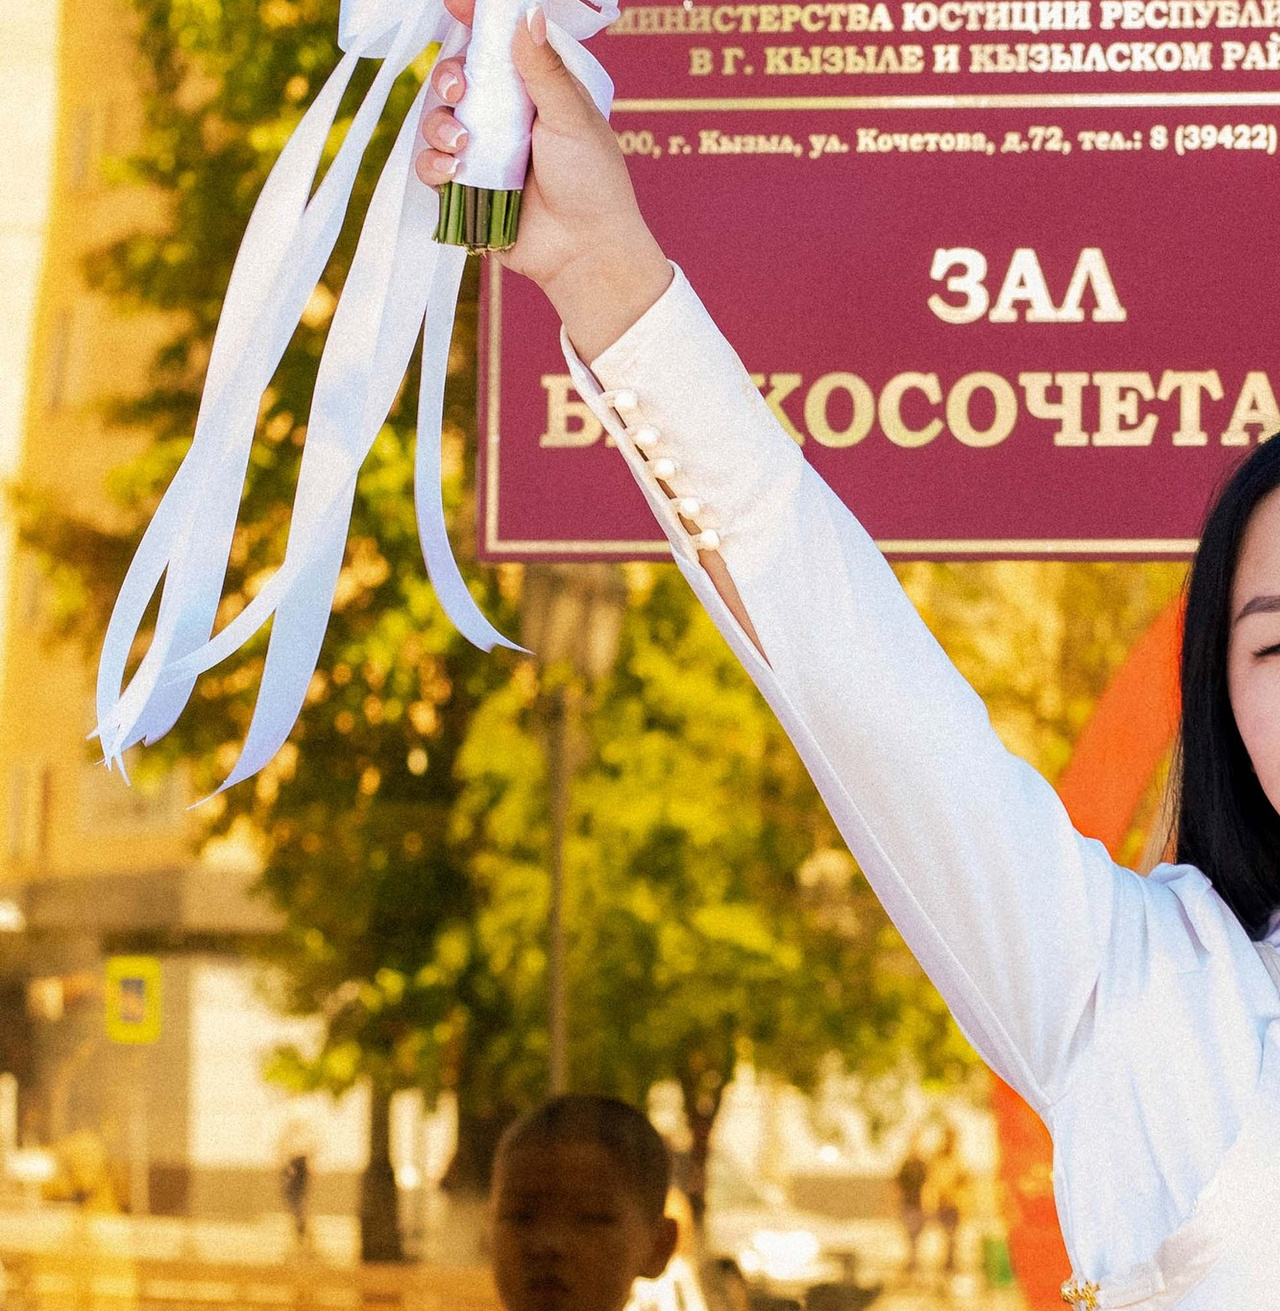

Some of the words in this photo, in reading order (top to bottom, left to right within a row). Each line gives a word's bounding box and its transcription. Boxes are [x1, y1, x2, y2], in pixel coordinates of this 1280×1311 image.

[901, 0, 1092, 34] ЮСТИЦИИ
[689, 47, 713, 76] В
[722, 47, 754, 75] Г.
[765, 44, 925, 75] КЫЗЫЛЕ
[932, 44, 961, 73] И
[969, 41, 1213, 73] КЫЗЫЛСКОМ
[669, 135, 692, 155] г.
[698, 130, 803, 158] Кызыл,
[809, 134, 849, 159] ул.
[856, 128, 995, 156] Кочетова,
[1149, 125, 1169, 150] 8
[1174, 124, 1278, 155] (39422)
[928, 247, 1128, 324] ЗАЛ
